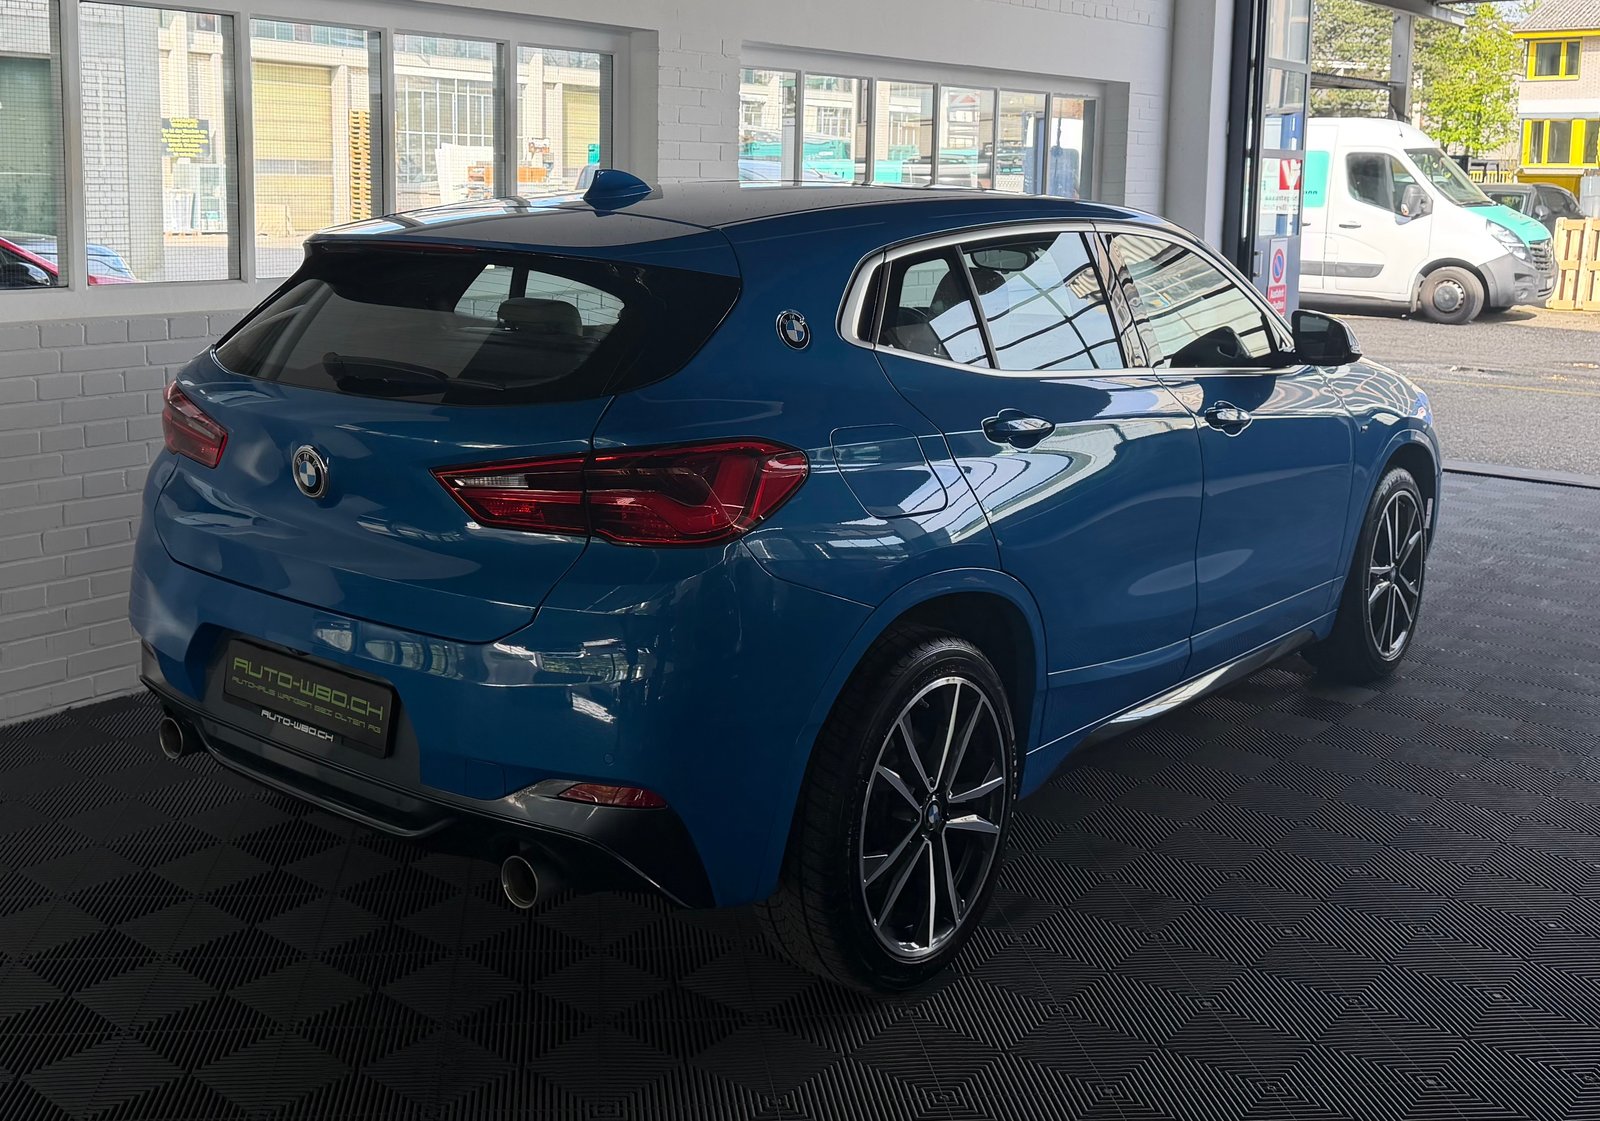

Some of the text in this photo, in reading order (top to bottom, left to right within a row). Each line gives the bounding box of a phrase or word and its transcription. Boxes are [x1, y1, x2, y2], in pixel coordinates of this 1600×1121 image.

[231, 676, 276, 696] AUTOHAUS
[277, 691, 312, 709] WANGEN
[334, 712, 366, 728] OLTEN
[367, 723, 381, 734] AG
